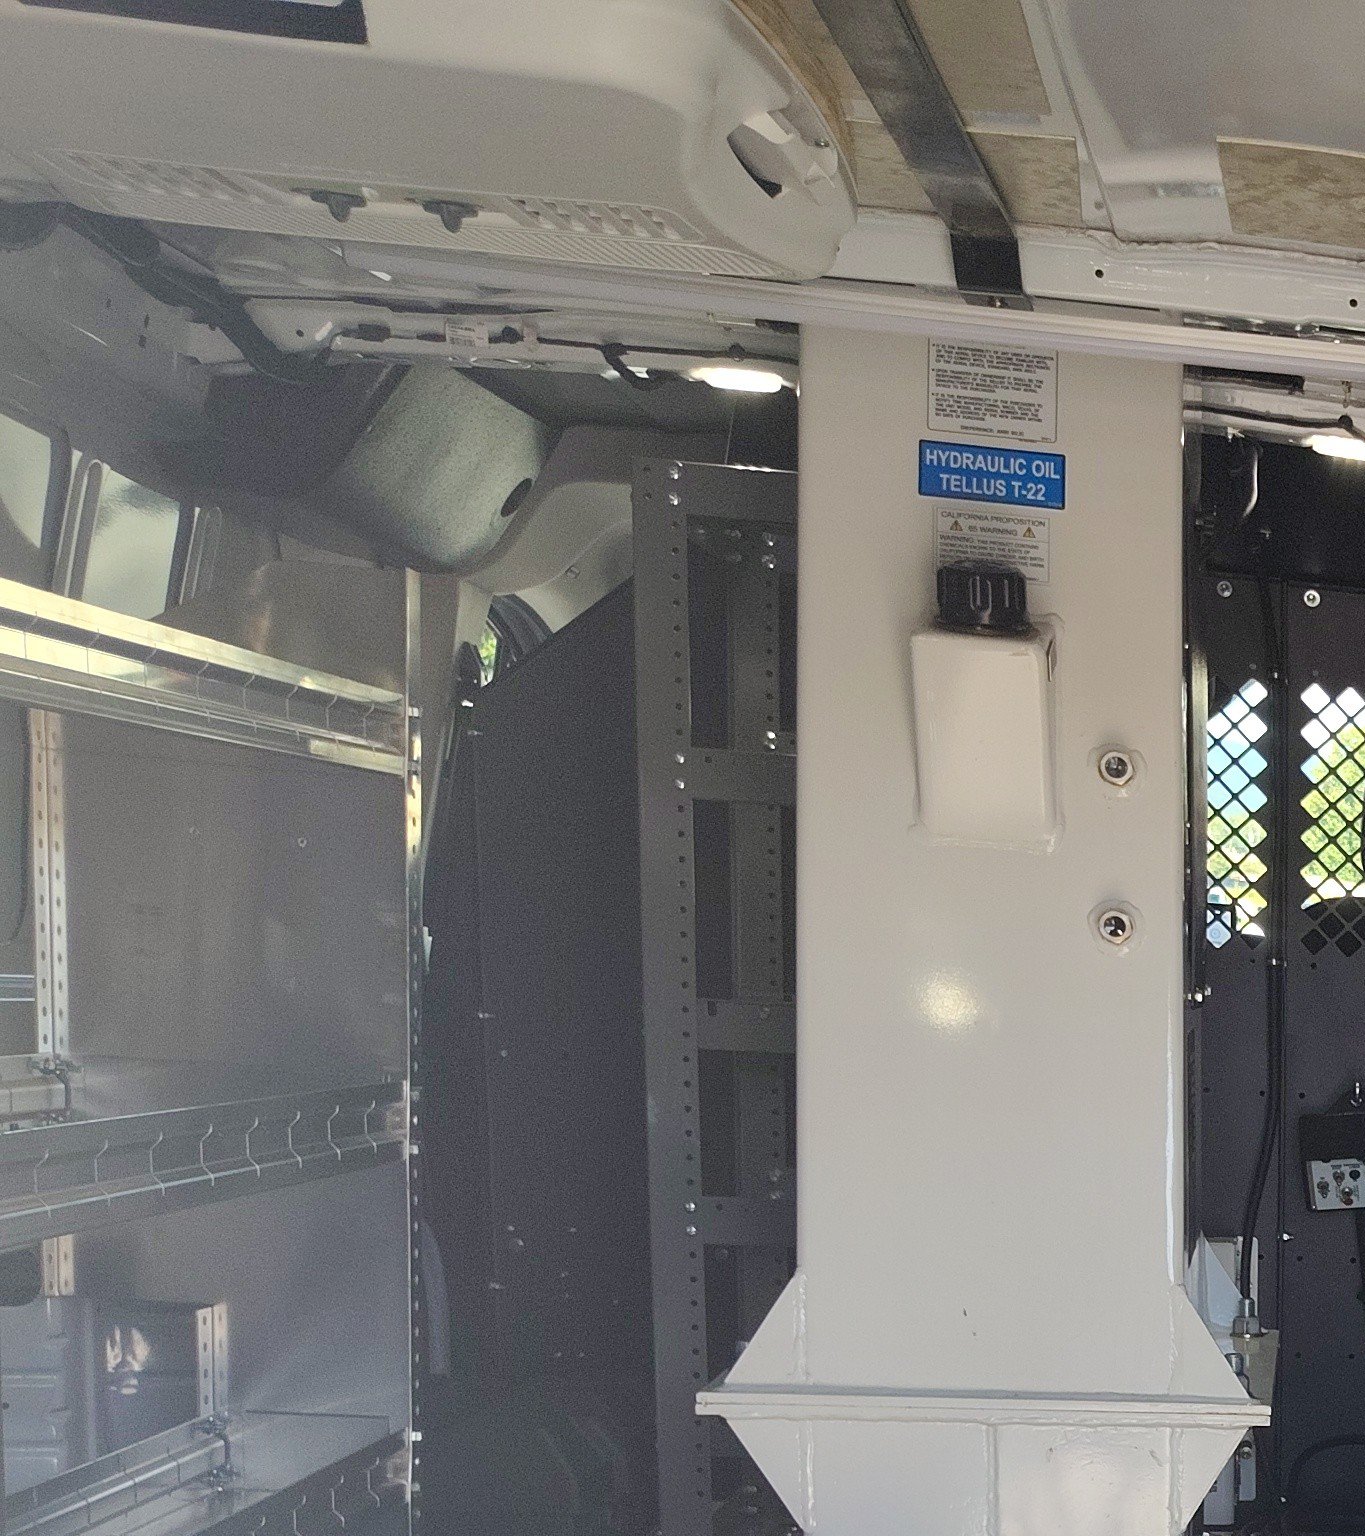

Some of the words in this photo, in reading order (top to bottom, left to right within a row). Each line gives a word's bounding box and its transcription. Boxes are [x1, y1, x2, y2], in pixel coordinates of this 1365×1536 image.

[926, 449, 1027, 476] HYDRAULIC
[1032, 460, 1060, 480] OIL
[940, 474, 1006, 497] TELLUS
[1011, 481, 1046, 501] T-22
[941, 511, 988, 522] CALIFORNIA
[991, 516, 1045, 527] PROPOSITION
[980, 526, 1018, 536] WARNING
